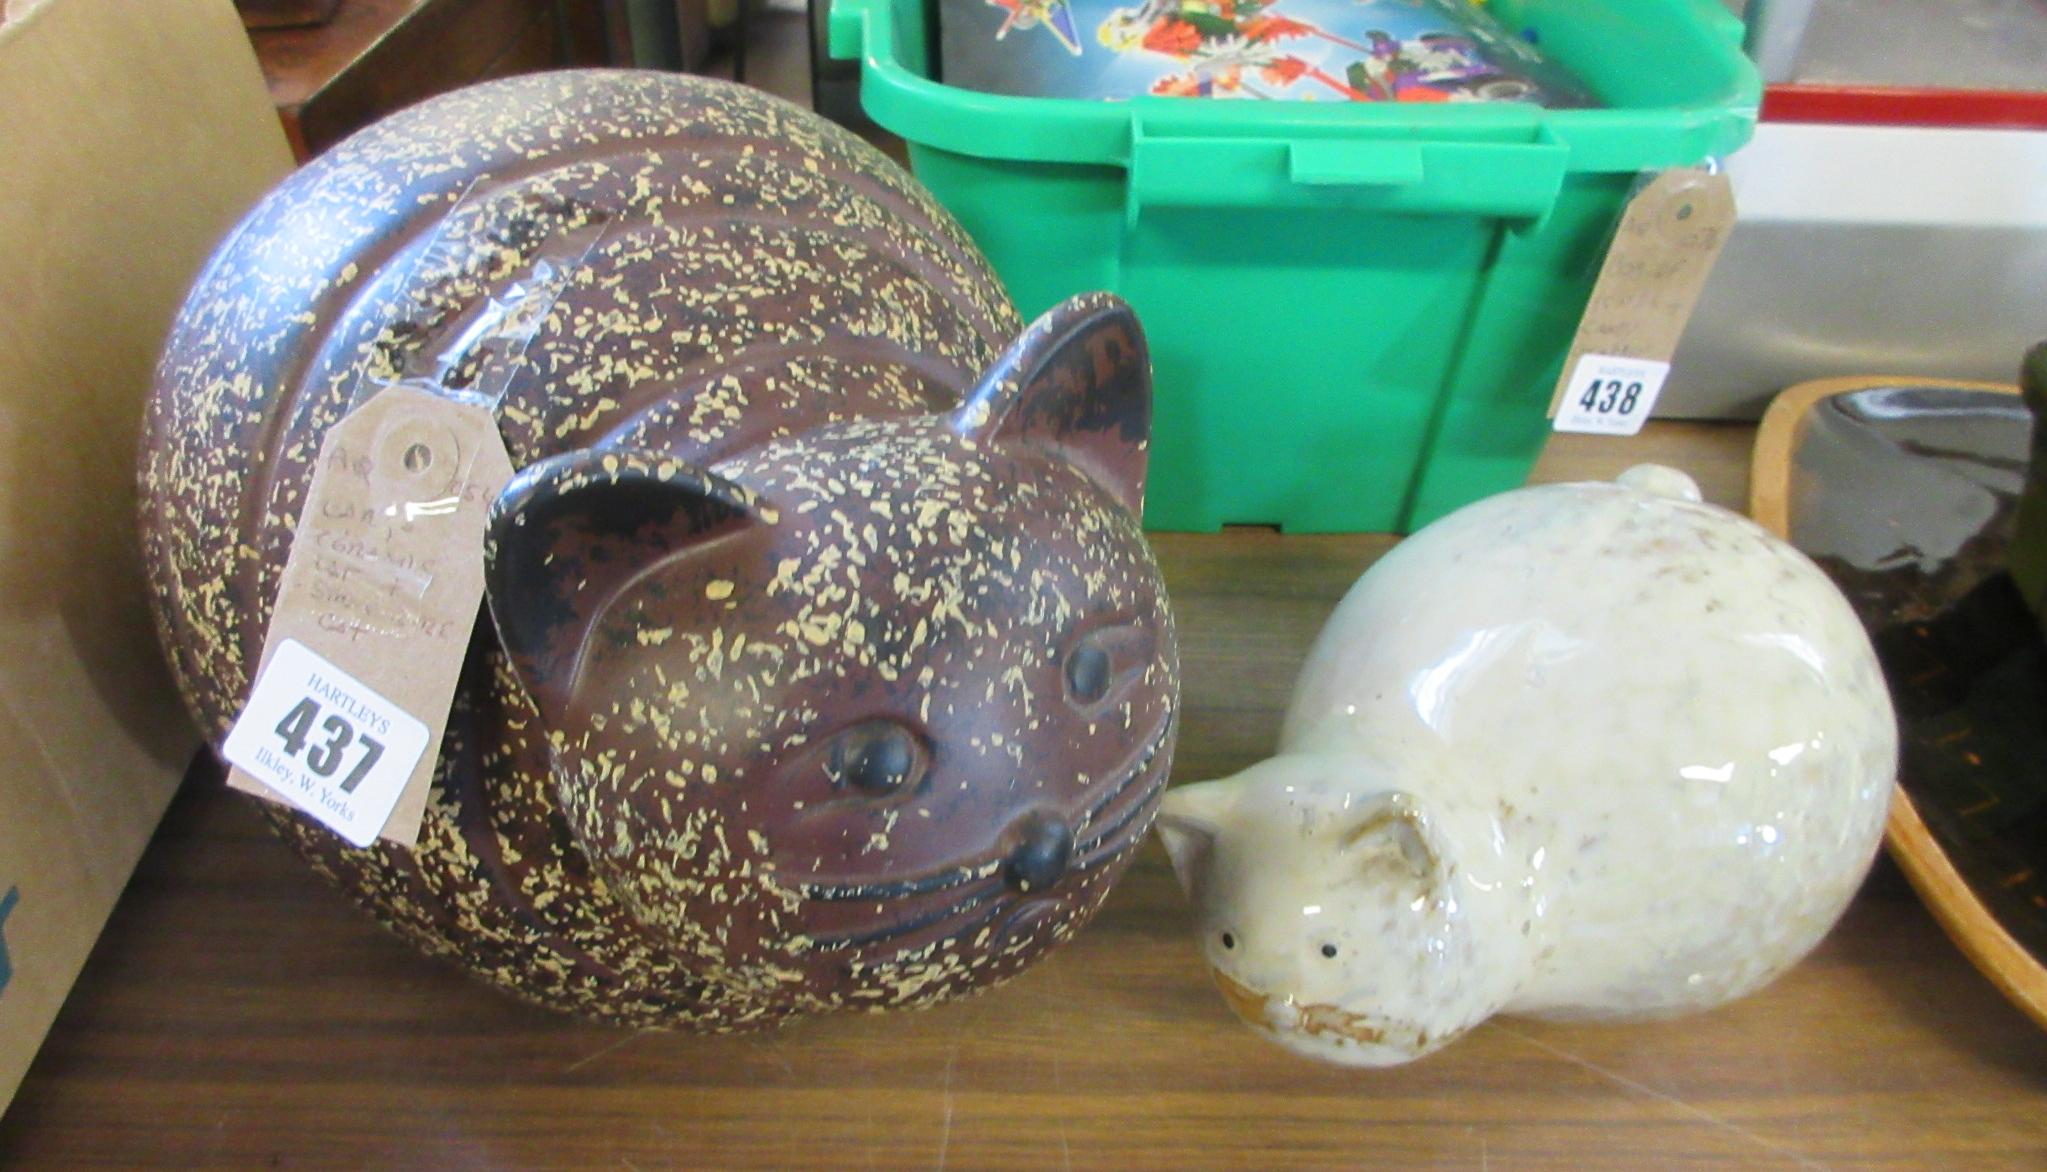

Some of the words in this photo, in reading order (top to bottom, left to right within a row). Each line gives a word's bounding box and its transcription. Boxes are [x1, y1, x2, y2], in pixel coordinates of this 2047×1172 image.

[1579, 380, 1643, 415] 438
[306, 672, 391, 735] HARTLEYS
[274, 696, 386, 795] 437
[254, 746, 294, 784] Ilkley,
[299, 772, 315, 797] W.
[321, 787, 355, 822] Yorks
